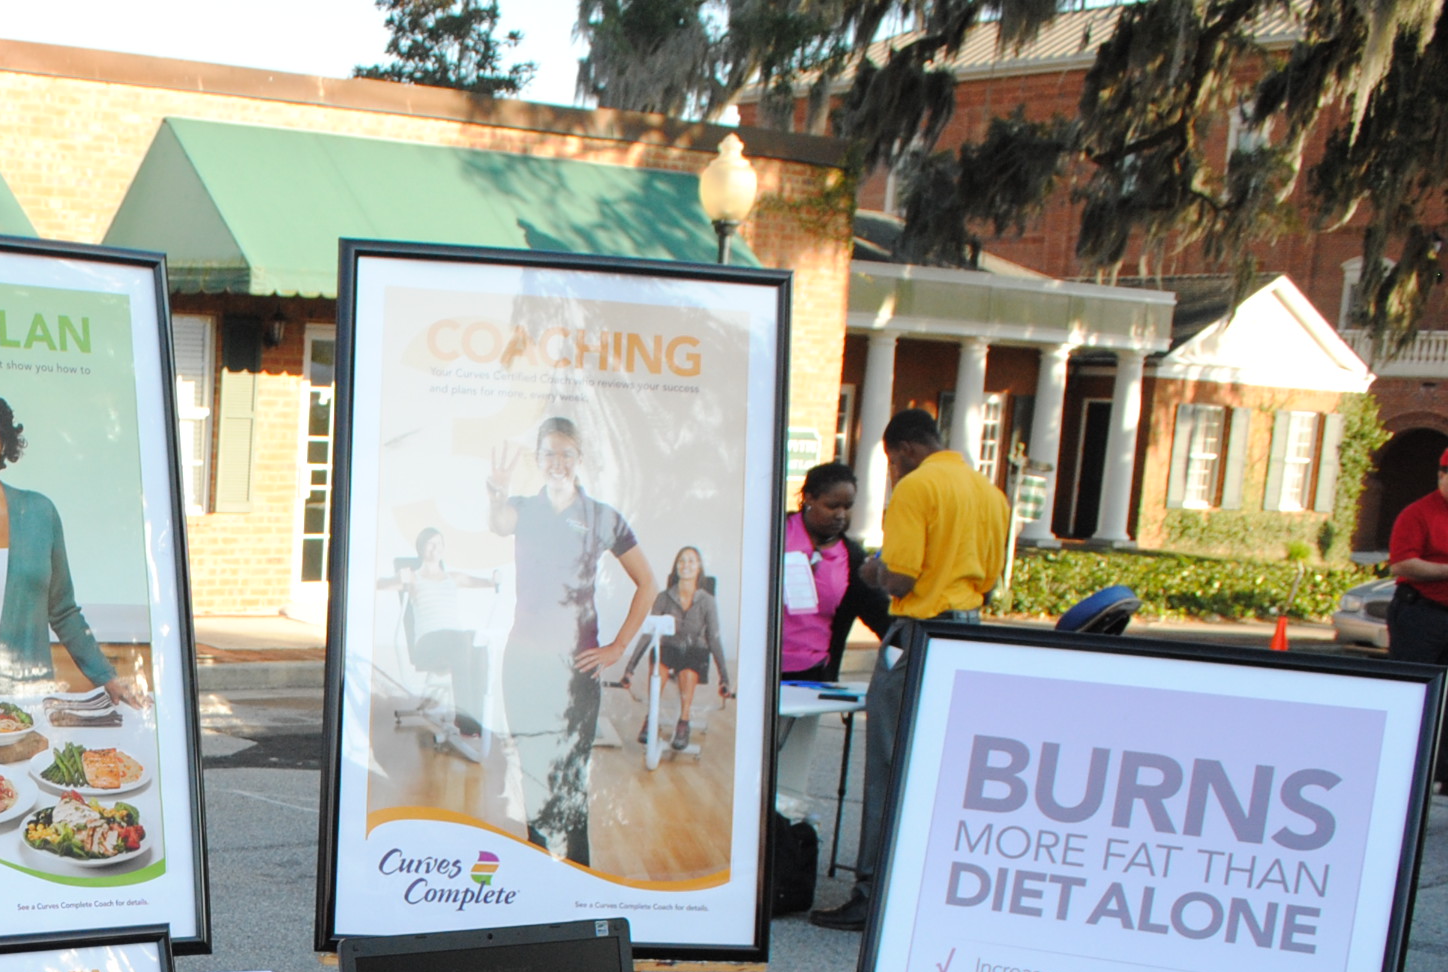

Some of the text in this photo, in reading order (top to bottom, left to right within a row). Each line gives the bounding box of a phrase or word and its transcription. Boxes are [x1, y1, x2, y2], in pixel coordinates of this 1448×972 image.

[6, 360, 32, 372] show
[35, 363, 54, 375] you
[56, 363, 77, 374] how
[80, 365, 91, 375] to
[427, 319, 702, 377] COACHING
[962, 734, 1343, 851] BURNS
[378, 848, 462, 878] Curves
[954, 820, 1330, 898] MORE FAT THAN
[403, 877, 517, 912] Complete
[945, 861, 1322, 954] DIET ALONE
